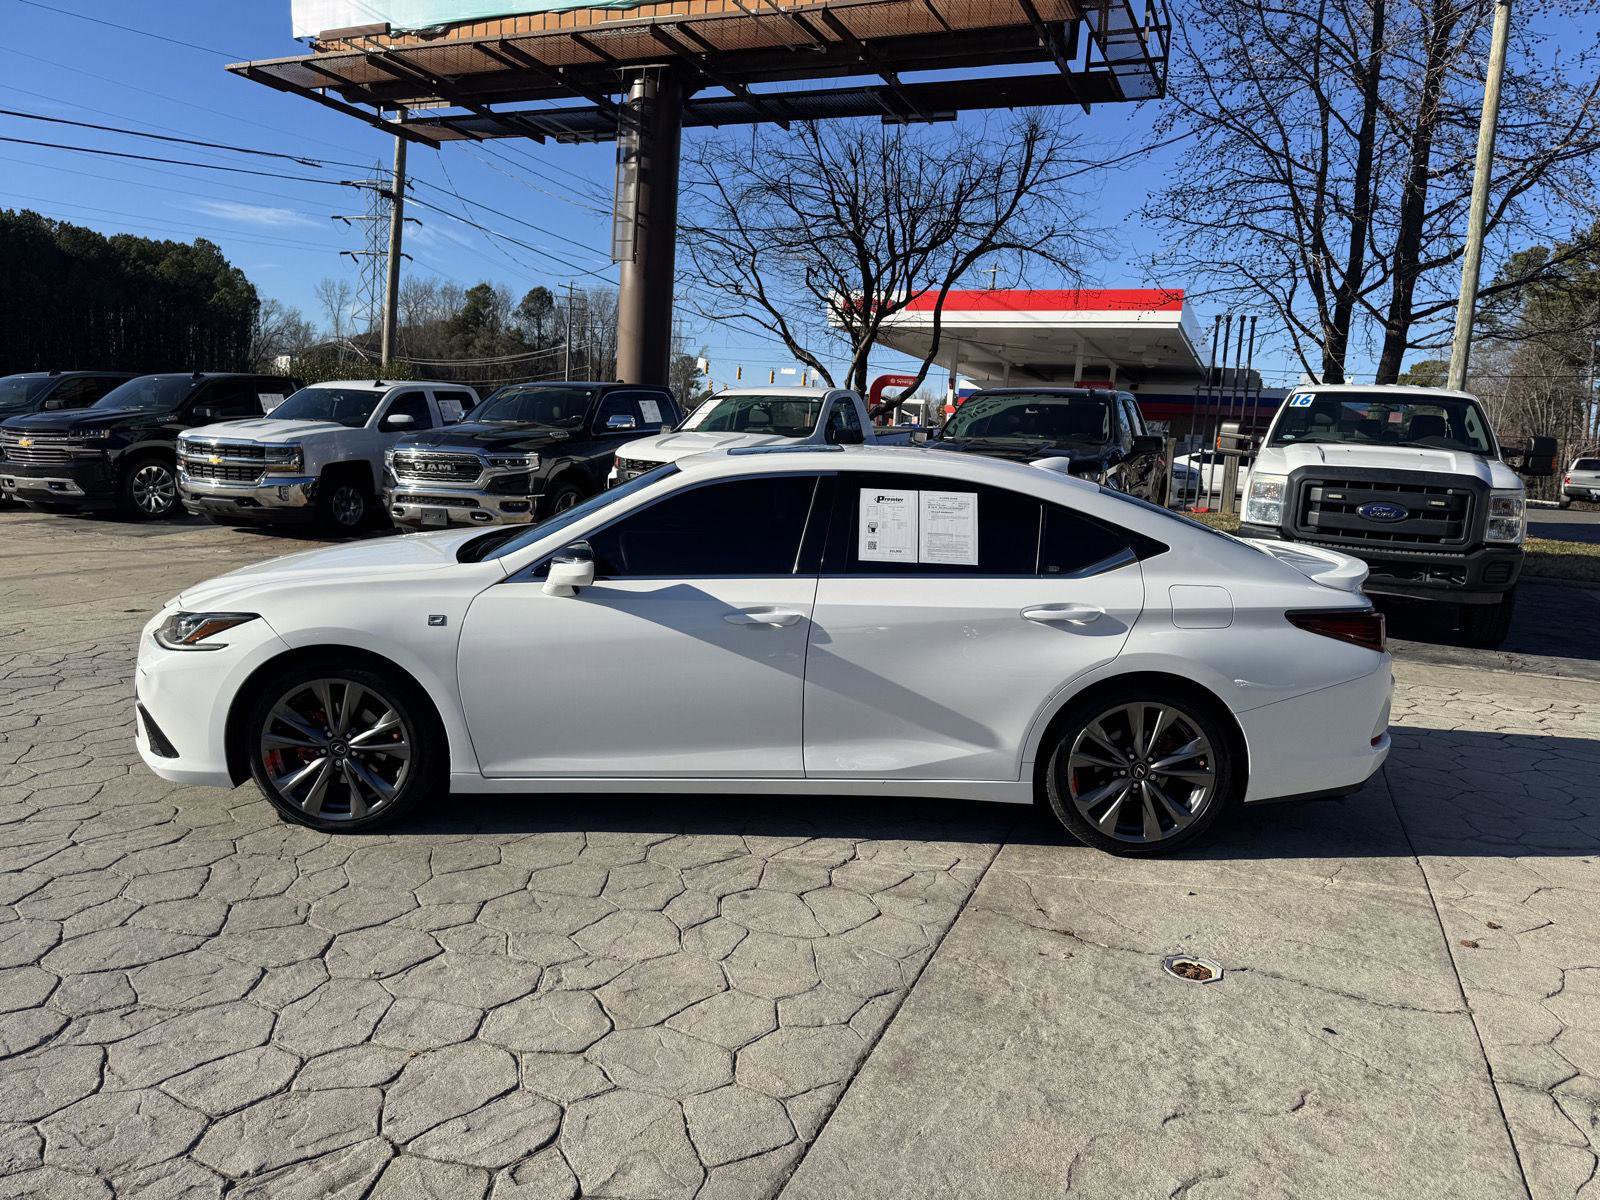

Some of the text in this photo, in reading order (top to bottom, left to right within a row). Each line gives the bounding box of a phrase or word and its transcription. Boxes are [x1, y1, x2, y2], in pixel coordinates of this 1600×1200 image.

[1291, 394, 1312, 406] 16
[414, 462, 451, 472] RAM
[876, 495, 904, 504] Premier
[1369, 506, 1398, 518] Ford
